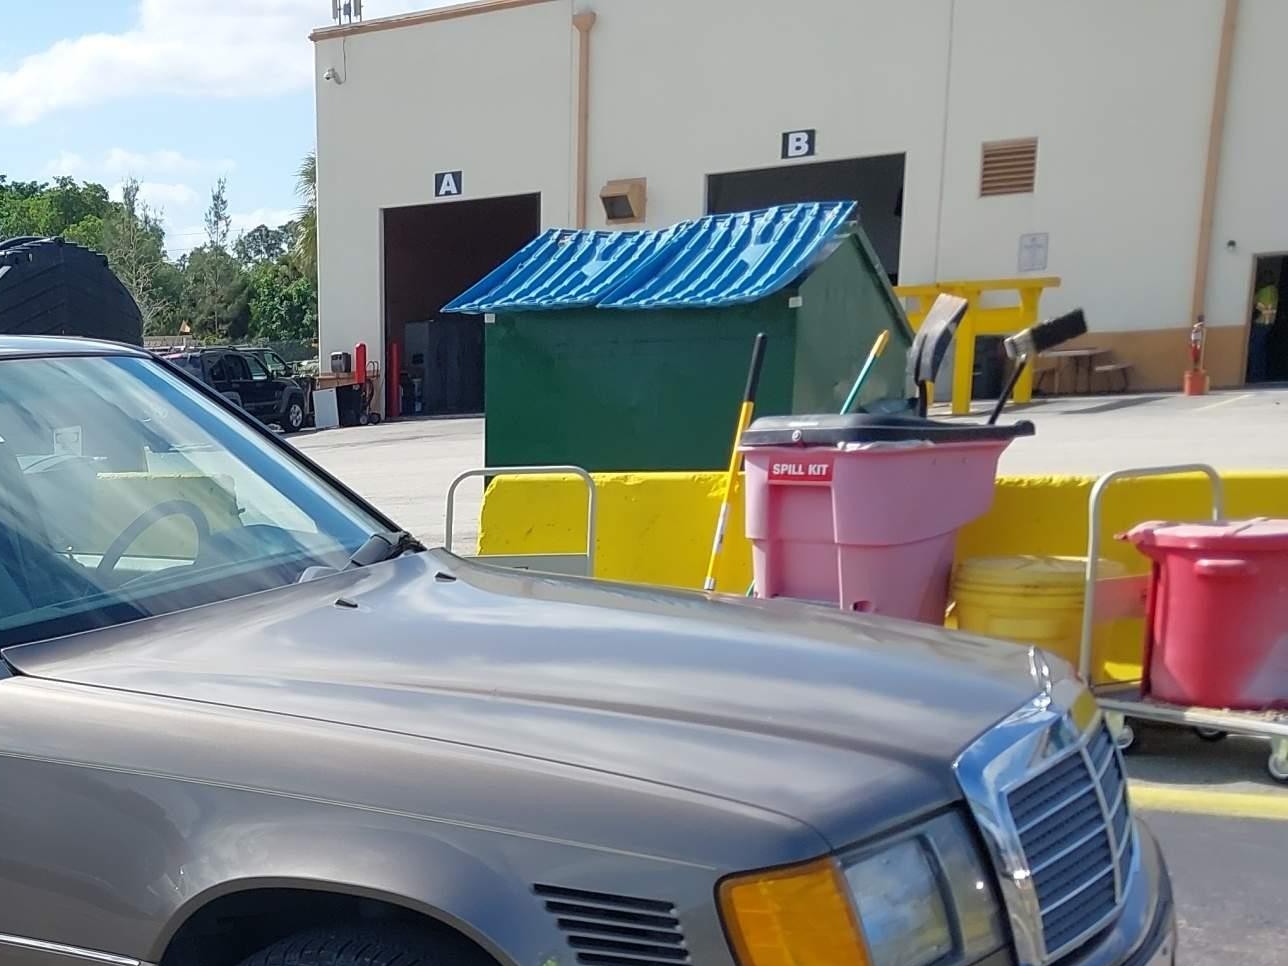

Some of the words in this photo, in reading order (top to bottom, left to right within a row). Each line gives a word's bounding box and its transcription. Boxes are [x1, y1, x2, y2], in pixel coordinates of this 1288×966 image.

[788, 132, 809, 157] B
[439, 173, 458, 195] A
[772, 463, 805, 476] SPILL
[807, 463, 829, 476] KIT
